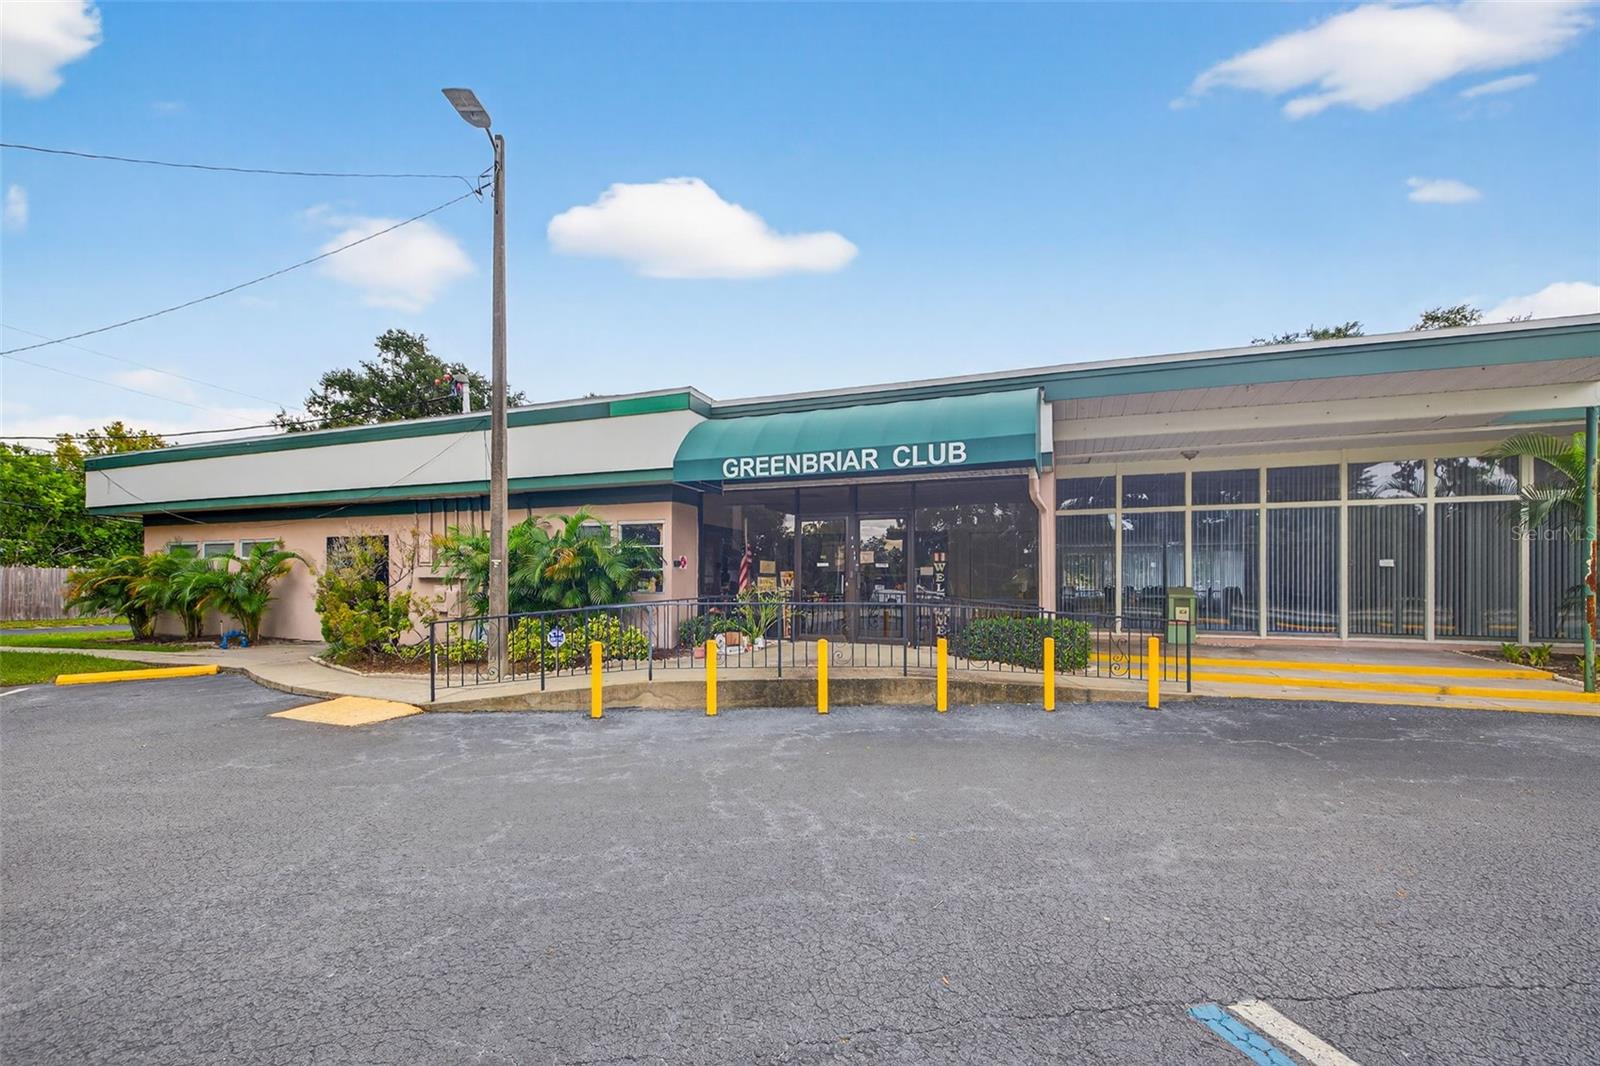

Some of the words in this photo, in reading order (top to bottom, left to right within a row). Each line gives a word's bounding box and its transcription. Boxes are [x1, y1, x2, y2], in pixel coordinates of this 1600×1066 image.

[722, 449, 879, 478] GREENBRIAR
[892, 442, 967, 467] CLUB
[933, 562, 950, 635] WELME
